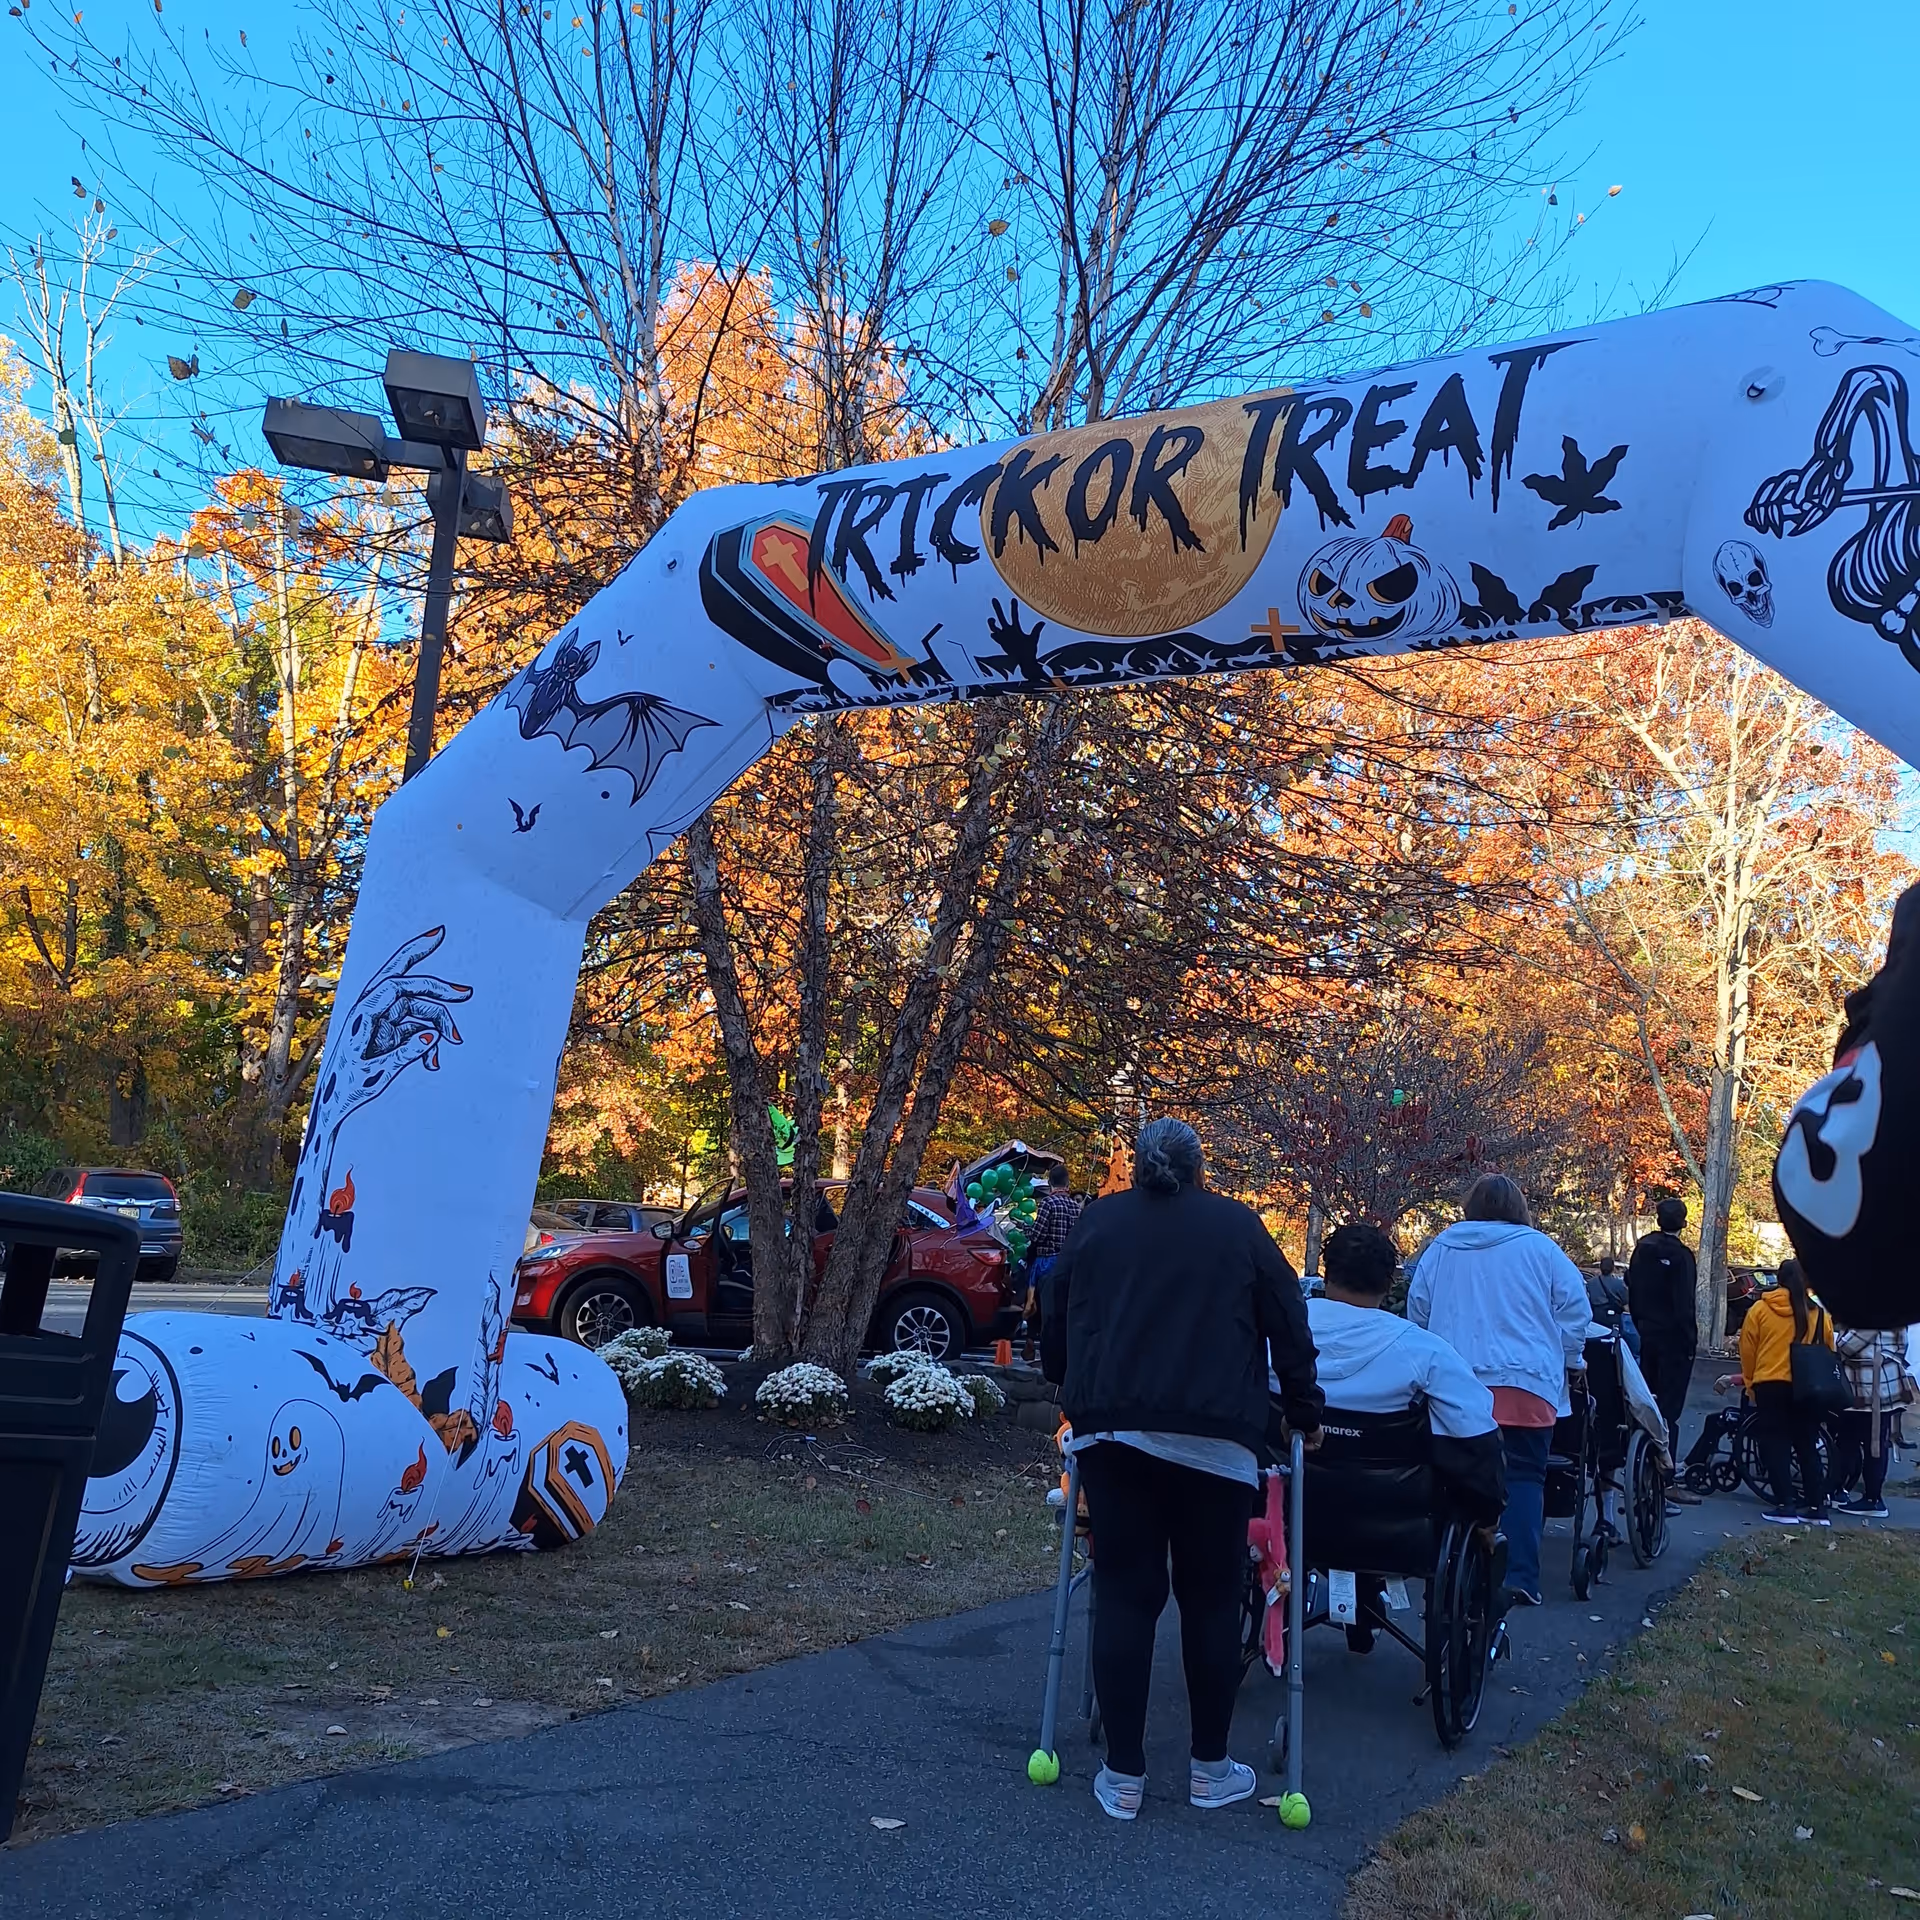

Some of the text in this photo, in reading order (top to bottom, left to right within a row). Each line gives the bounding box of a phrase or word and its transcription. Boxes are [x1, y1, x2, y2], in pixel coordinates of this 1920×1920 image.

[807, 338, 1599, 618] TRICK OR TREAT
